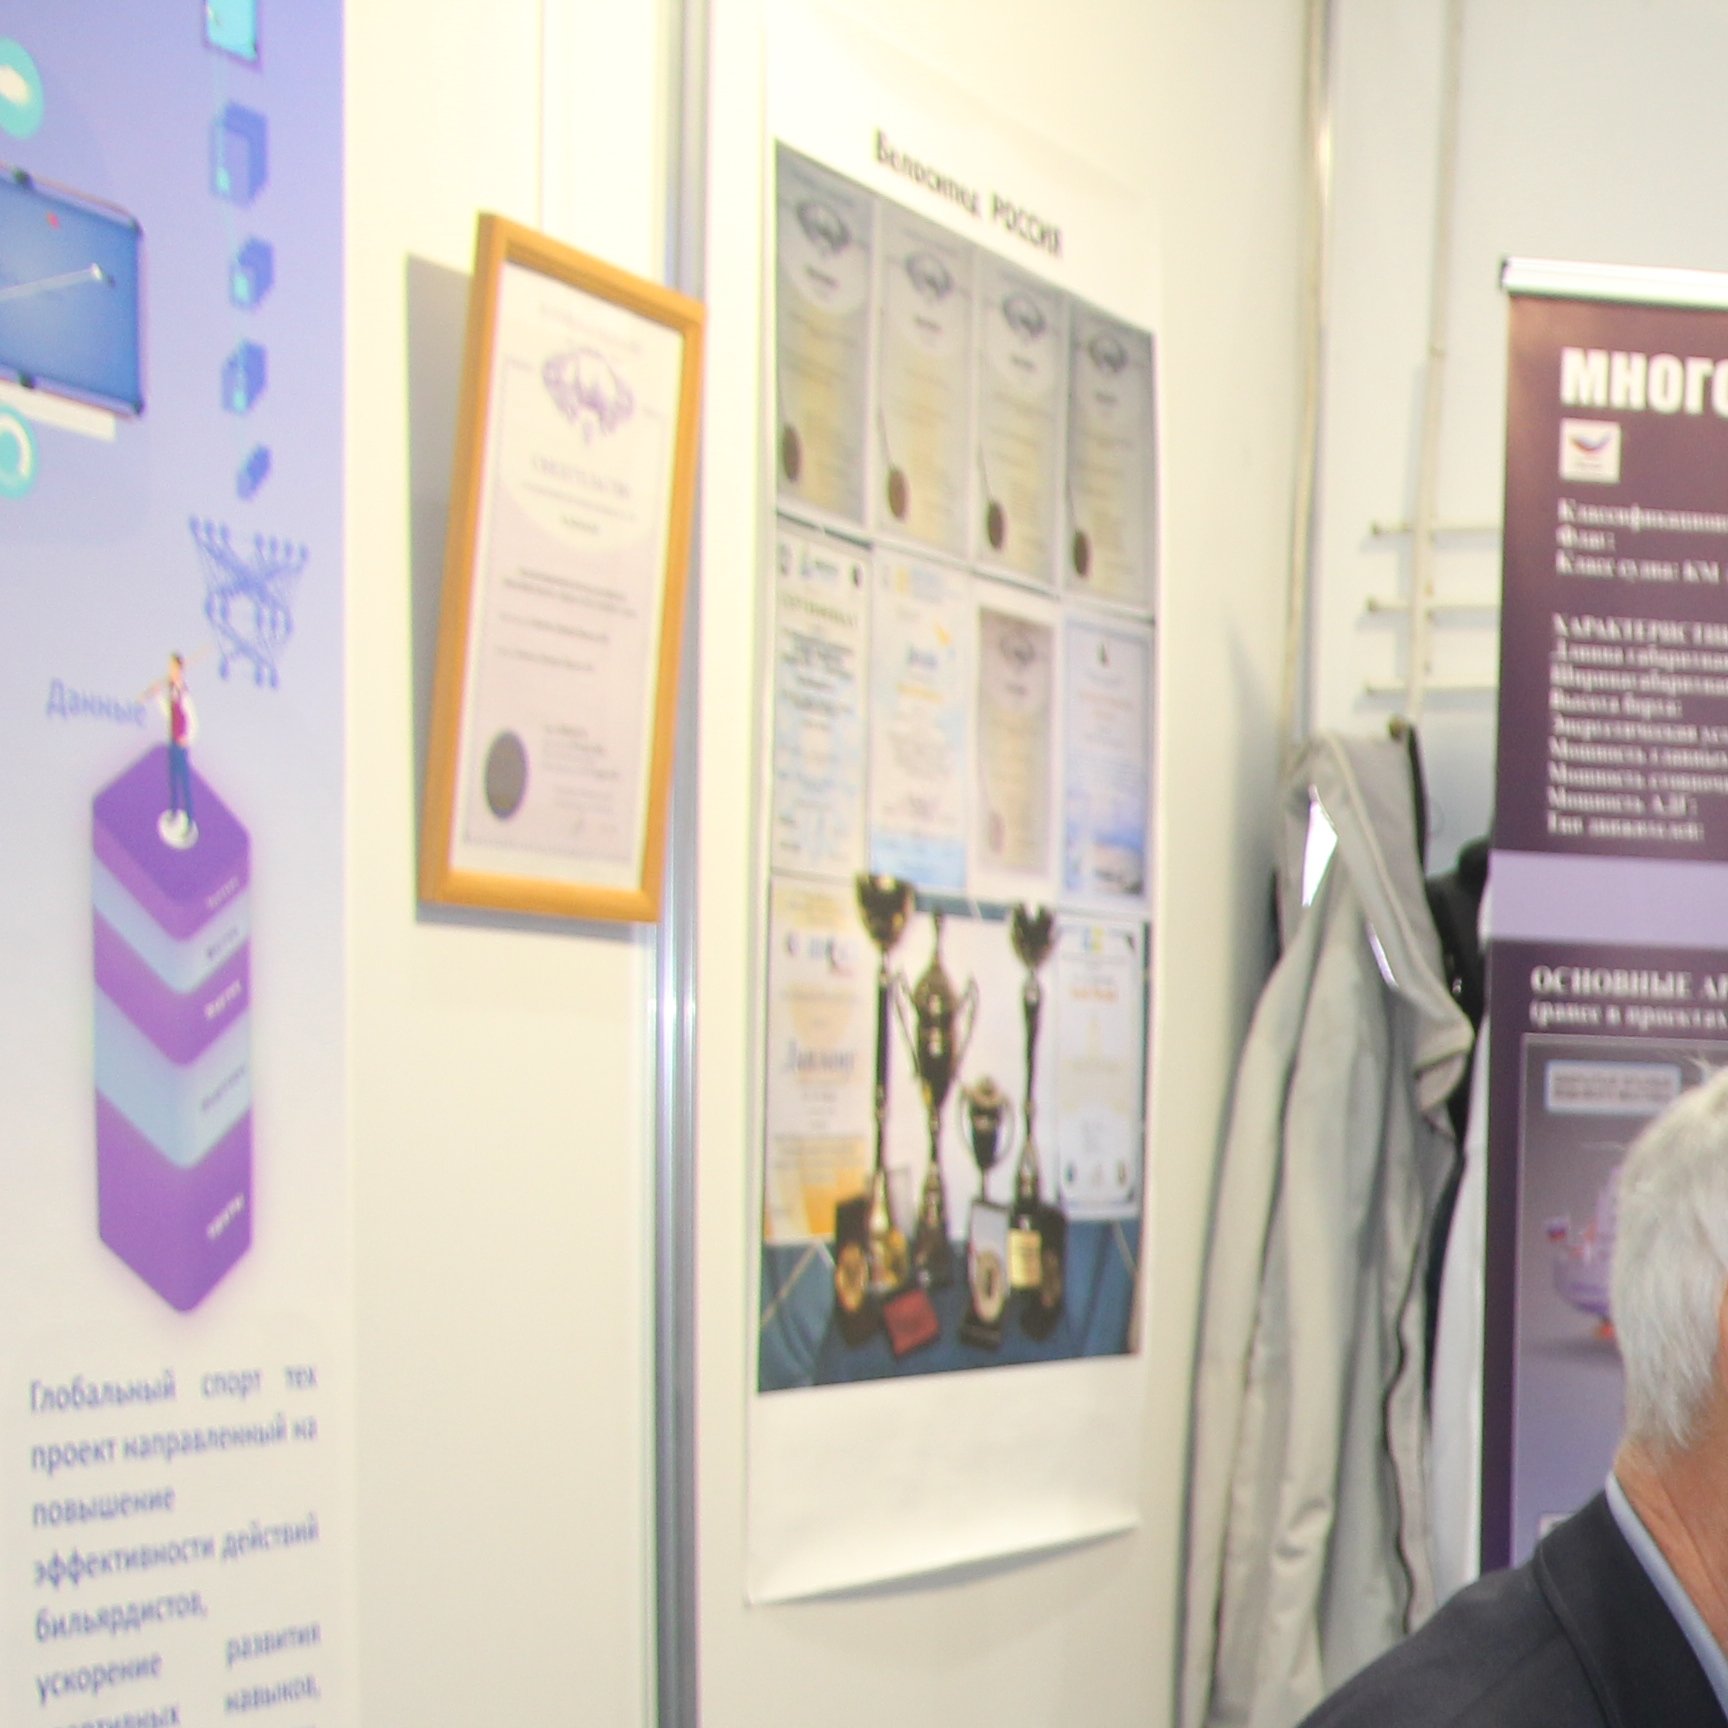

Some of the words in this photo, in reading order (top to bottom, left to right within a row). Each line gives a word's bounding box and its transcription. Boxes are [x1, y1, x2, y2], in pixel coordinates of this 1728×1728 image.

[990, 190, 1063, 258] РОССИЯ
[46, 676, 150, 729] Данные
[1530, 965, 1693, 1001] ОСНОВНЫЕ
[30, 1367, 176, 1414] Глобальный
[201, 1367, 262, 1402] спорт
[30, 1436, 117, 1478] проект
[122, 1411, 287, 1464] направленный
[292, 1415, 318, 1442] на
[32, 1486, 176, 1528] повышение
[34, 1535, 215, 1590] эффективности
[220, 1511, 319, 1561] действий
[36, 1653, 163, 1706] ускорение
